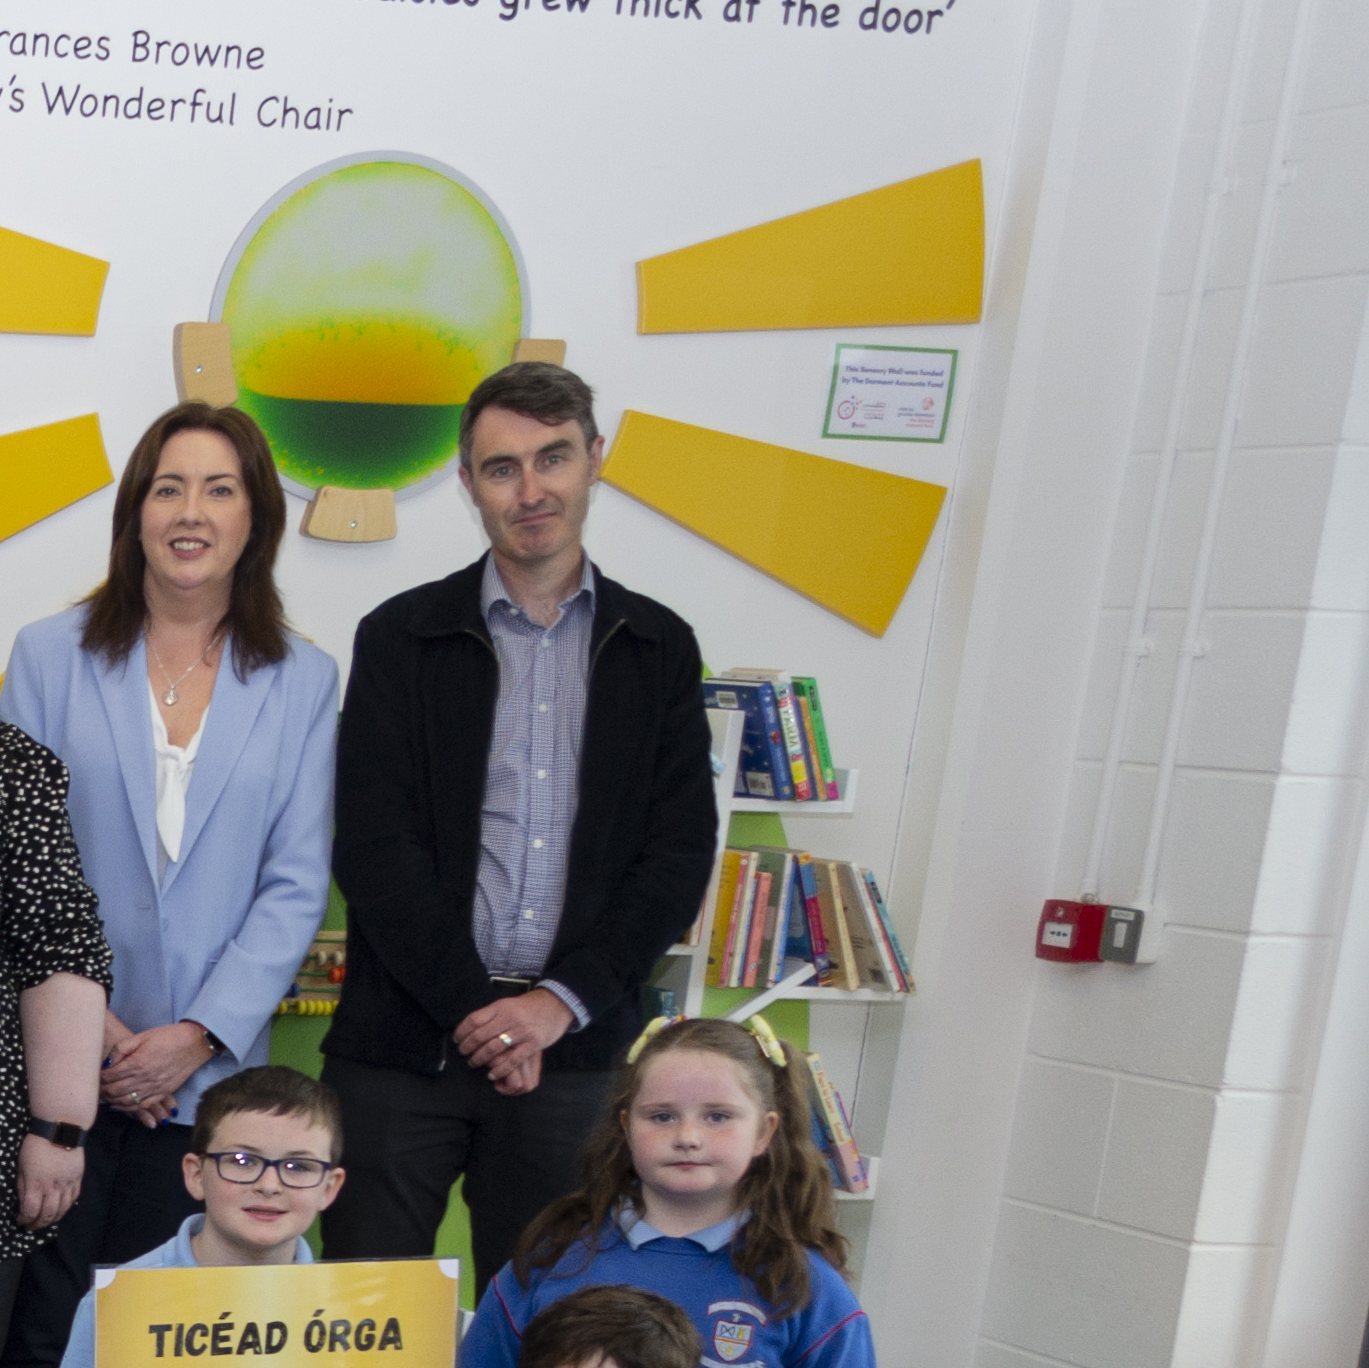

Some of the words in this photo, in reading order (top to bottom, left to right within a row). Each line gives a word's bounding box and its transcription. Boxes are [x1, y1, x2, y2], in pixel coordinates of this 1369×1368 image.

[781, 0, 840, 28] the
[130, 30, 266, 71] Browne
[41, 81, 237, 127] Wonderful
[256, 96, 354, 132] Chair
[148, 1311, 289, 1358] TICÉAD
[303, 1309, 403, 1354] ÓRGA
